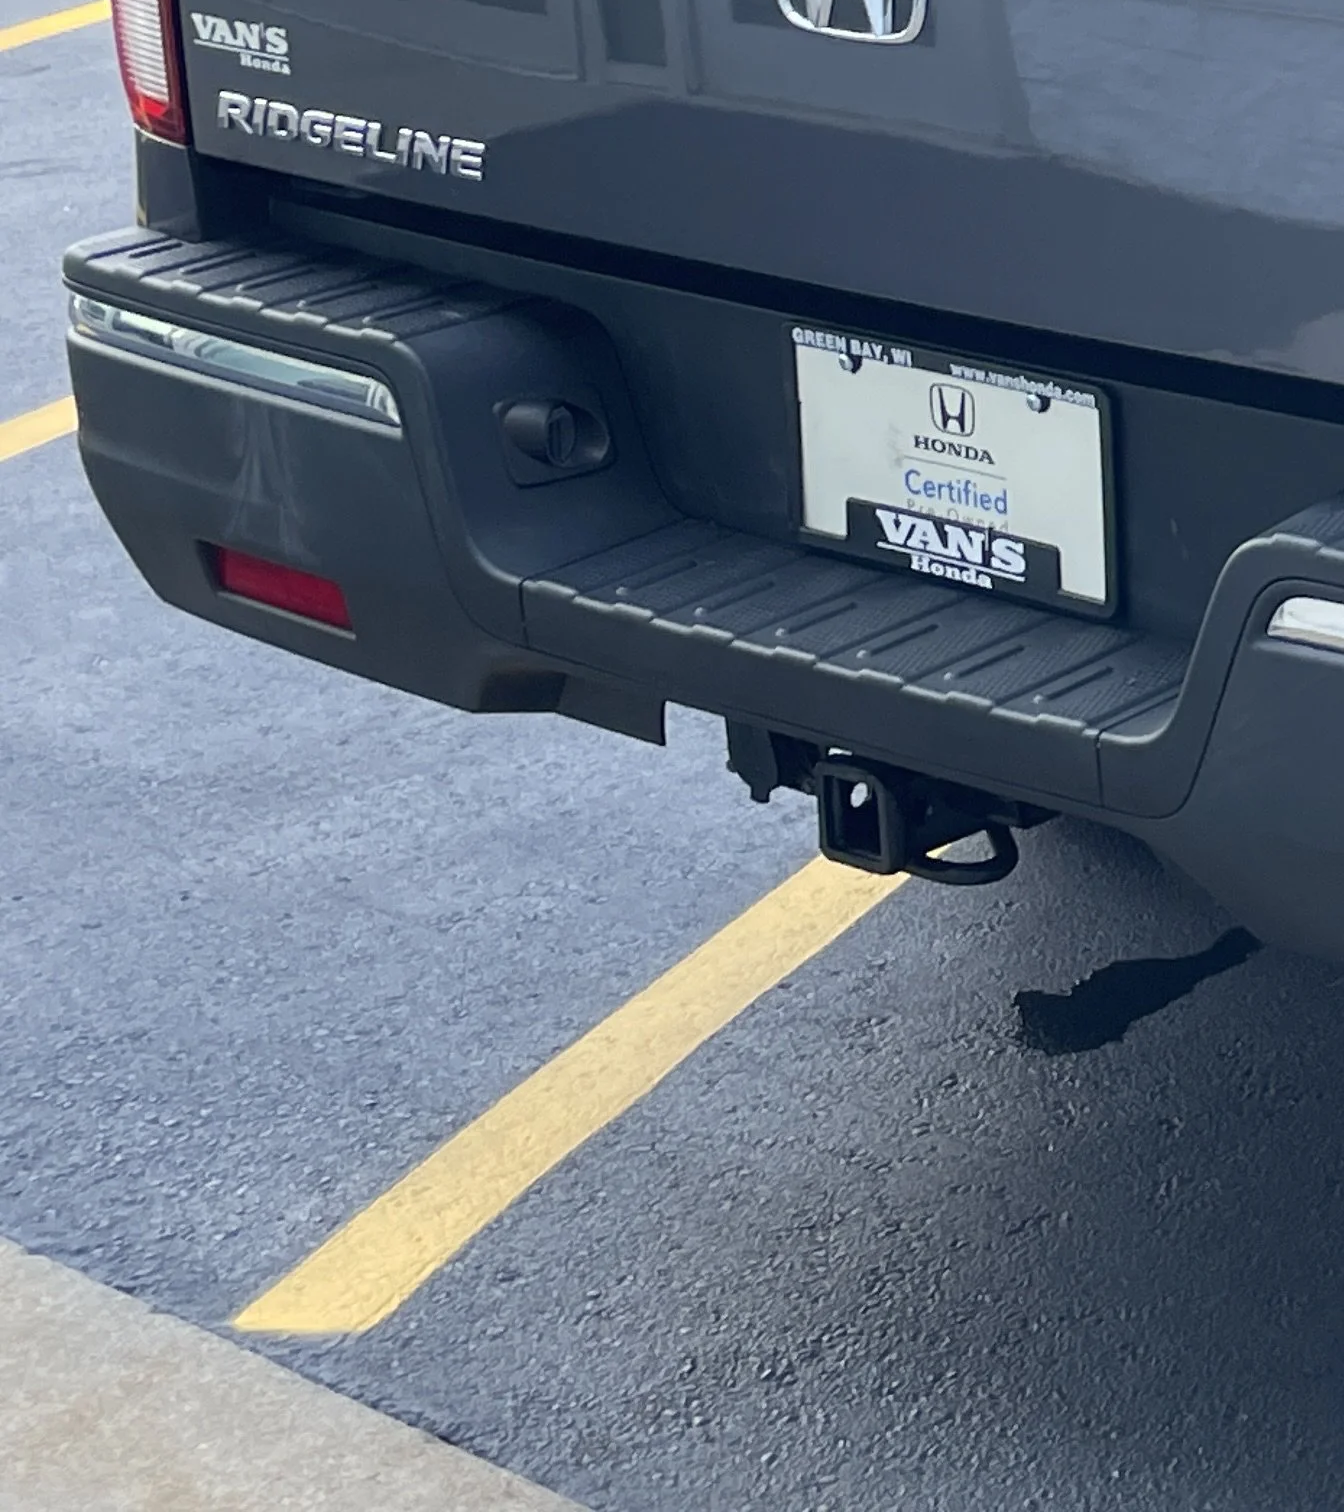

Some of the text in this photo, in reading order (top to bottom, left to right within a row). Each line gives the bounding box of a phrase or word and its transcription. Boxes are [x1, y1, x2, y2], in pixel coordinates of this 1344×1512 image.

[191, 12, 288, 55] VAN'S
[240, 53, 291, 76] Honda
[217, 90, 486, 181] RIDGELINE
[792, 327, 912, 368] GREEN BAY, WI
[914, 435, 995, 465] HONDA
[904, 468, 1008, 515] Certified
[875, 508, 1026, 574] VAN'S
[910, 555, 993, 589] Honda
